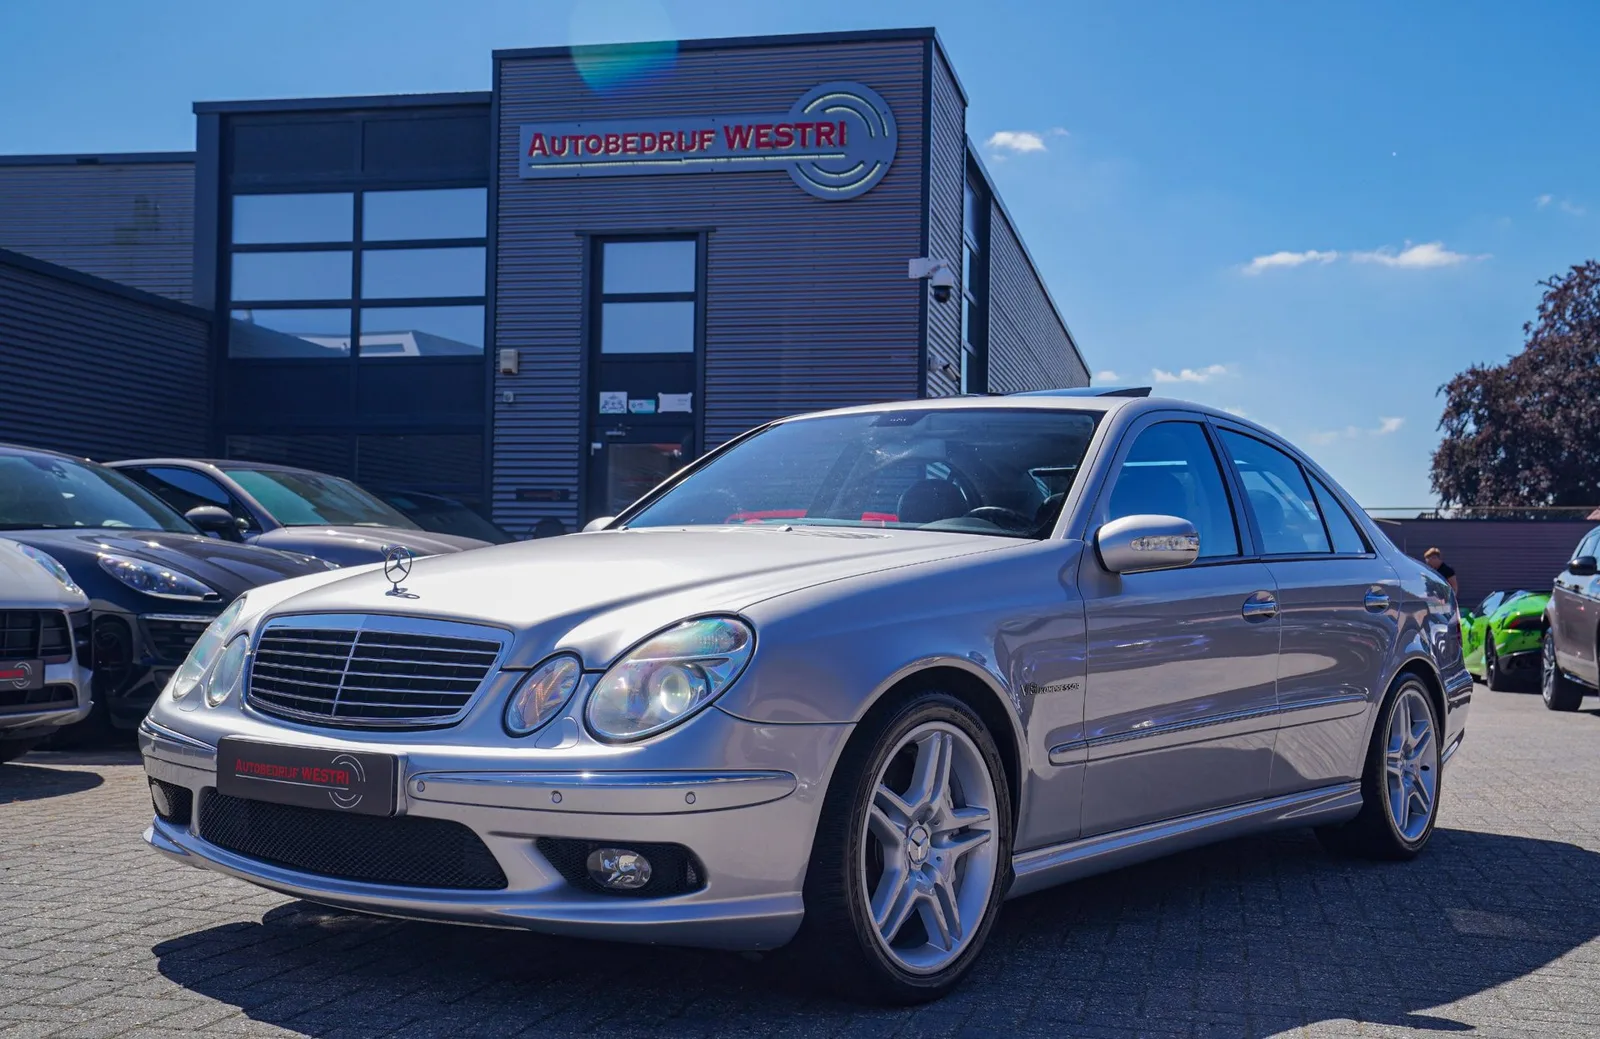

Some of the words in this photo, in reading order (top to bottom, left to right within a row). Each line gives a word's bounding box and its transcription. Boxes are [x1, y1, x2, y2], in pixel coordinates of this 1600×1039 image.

[528, 129, 716, 157] AUTOBEDRIJF
[723, 120, 847, 151] WESTRI
[235, 759, 299, 778] AUTOBEDRIJF
[302, 767, 349, 784] WESTRI
